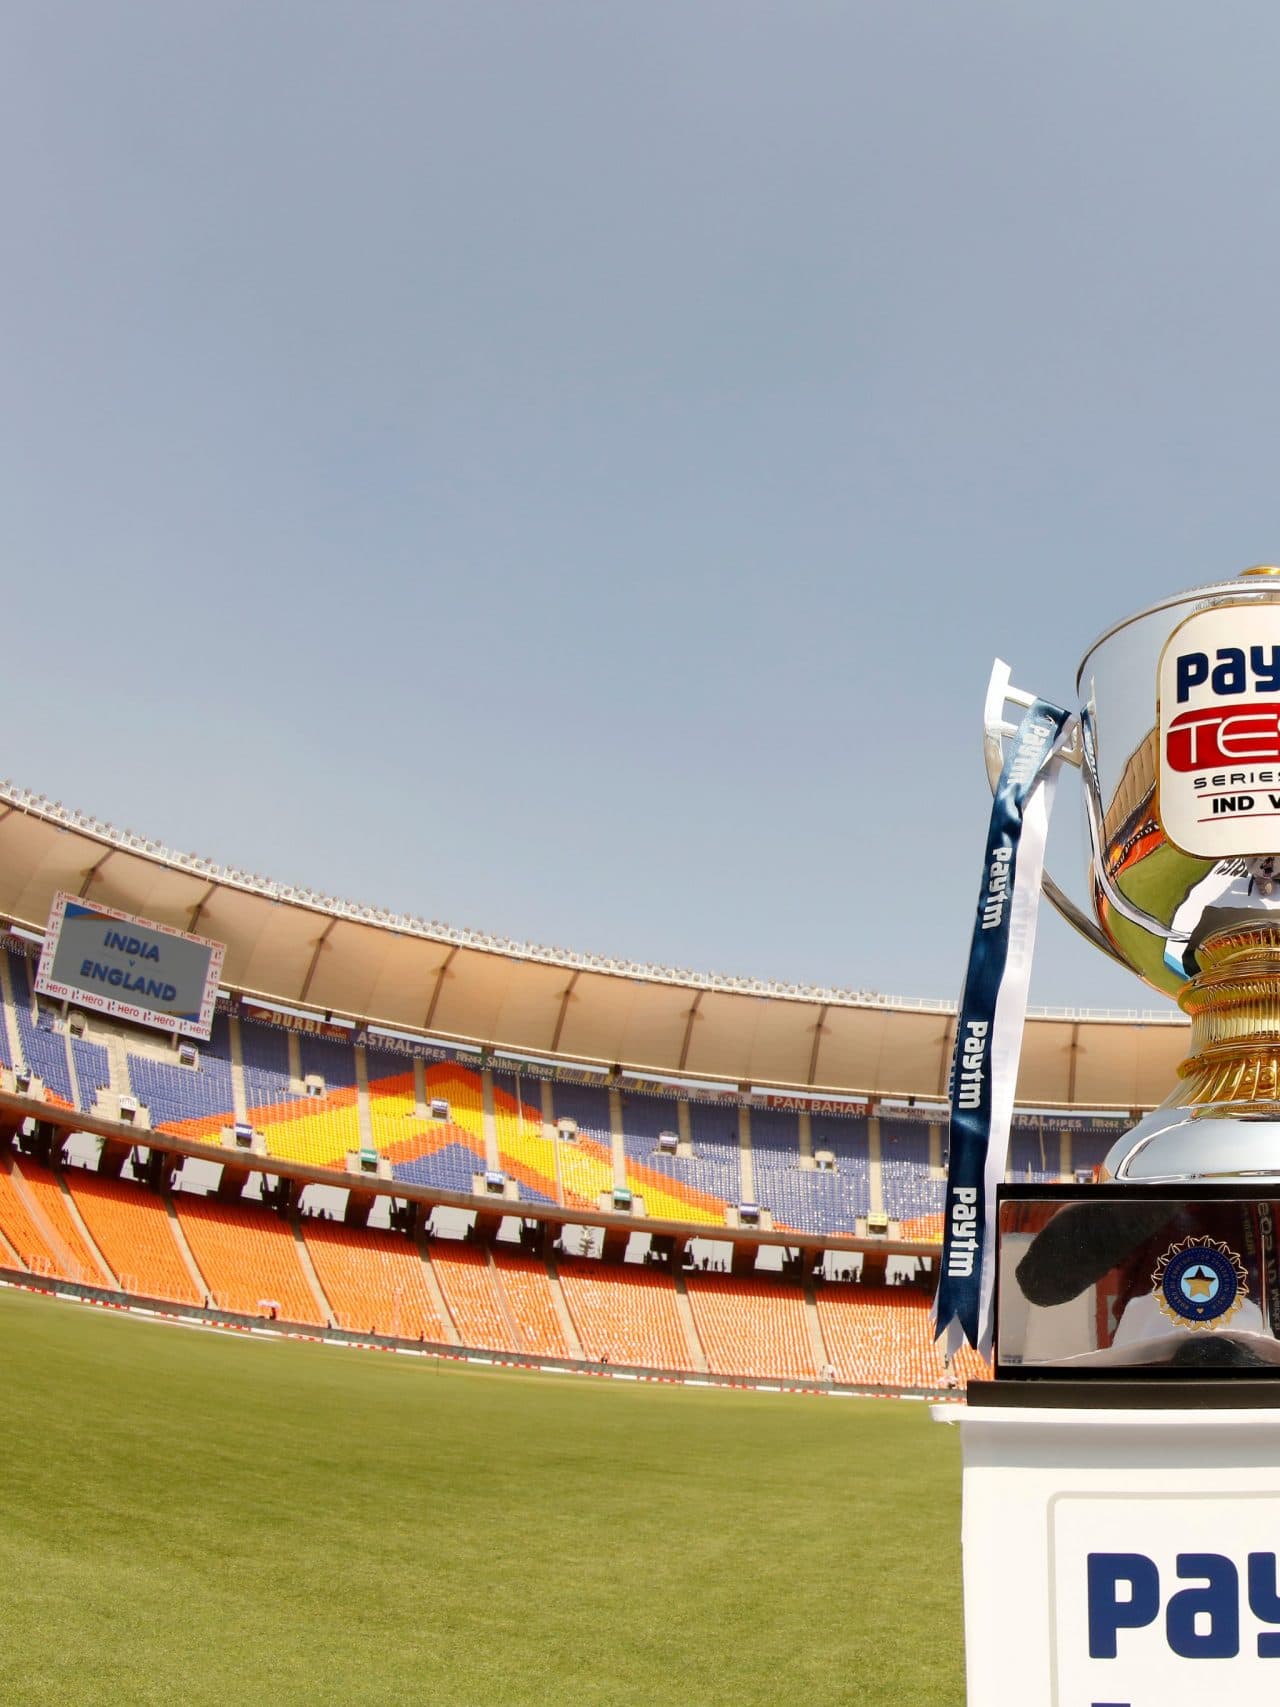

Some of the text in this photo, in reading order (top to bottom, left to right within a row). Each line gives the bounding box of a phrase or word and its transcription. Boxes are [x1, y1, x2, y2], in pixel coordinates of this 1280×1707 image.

[1212, 796, 1255, 814] IND
[982, 846, 1013, 930] paytm
[103, 931, 160, 962] INDIA
[80, 959, 177, 1002] ENGLAND
[357, 1031, 412, 1054] ASTRAL
[414, 1045, 447, 1059] PIPES
[958, 1021, 989, 1109] paytm
[773, 1096, 806, 1110] PAN
[811, 1100, 867, 1115] BAHAR
[1049, 1119, 1082, 1128] PIPES
[948, 1187, 980, 1277] paytm
